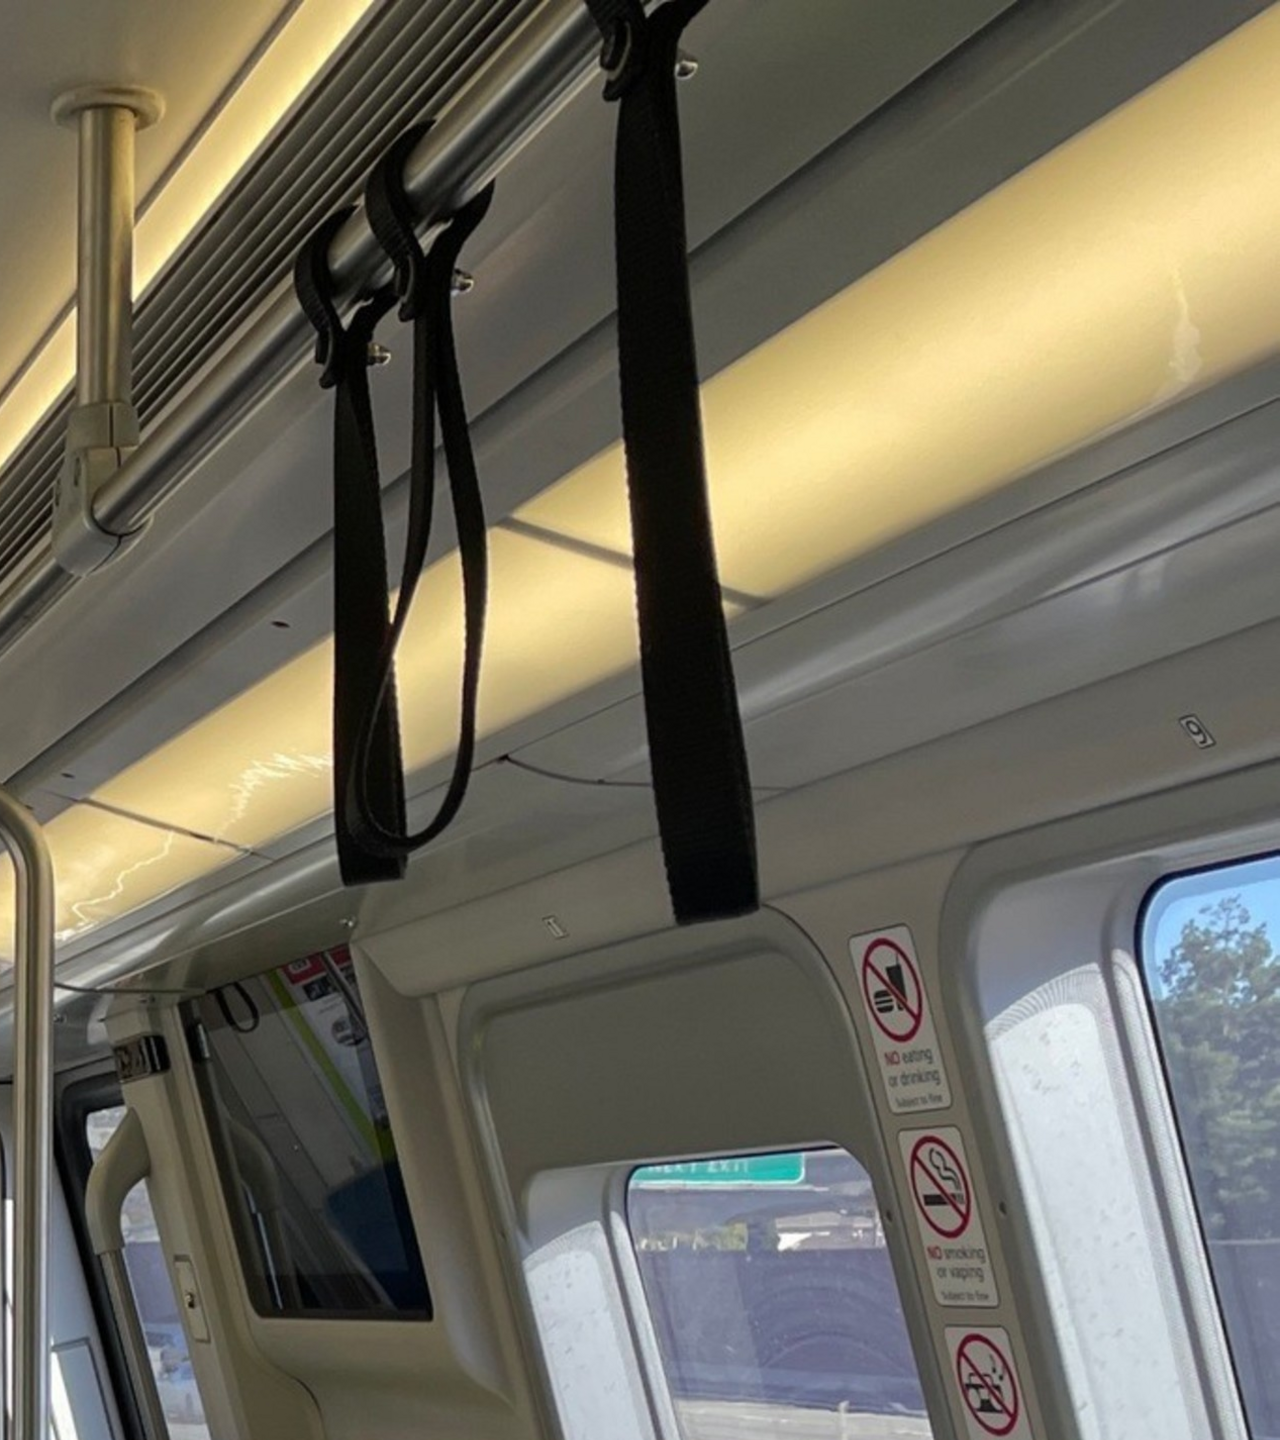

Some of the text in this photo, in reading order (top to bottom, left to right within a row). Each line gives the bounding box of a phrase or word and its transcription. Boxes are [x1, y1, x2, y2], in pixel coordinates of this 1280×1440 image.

[1186, 720, 1208, 745] 9
[884, 1048, 934, 1067] NO eating
[888, 1069, 942, 1089] or drinking
[926, 1245, 987, 1265] NO smoking
[937, 1266, 985, 1283] or vaping
